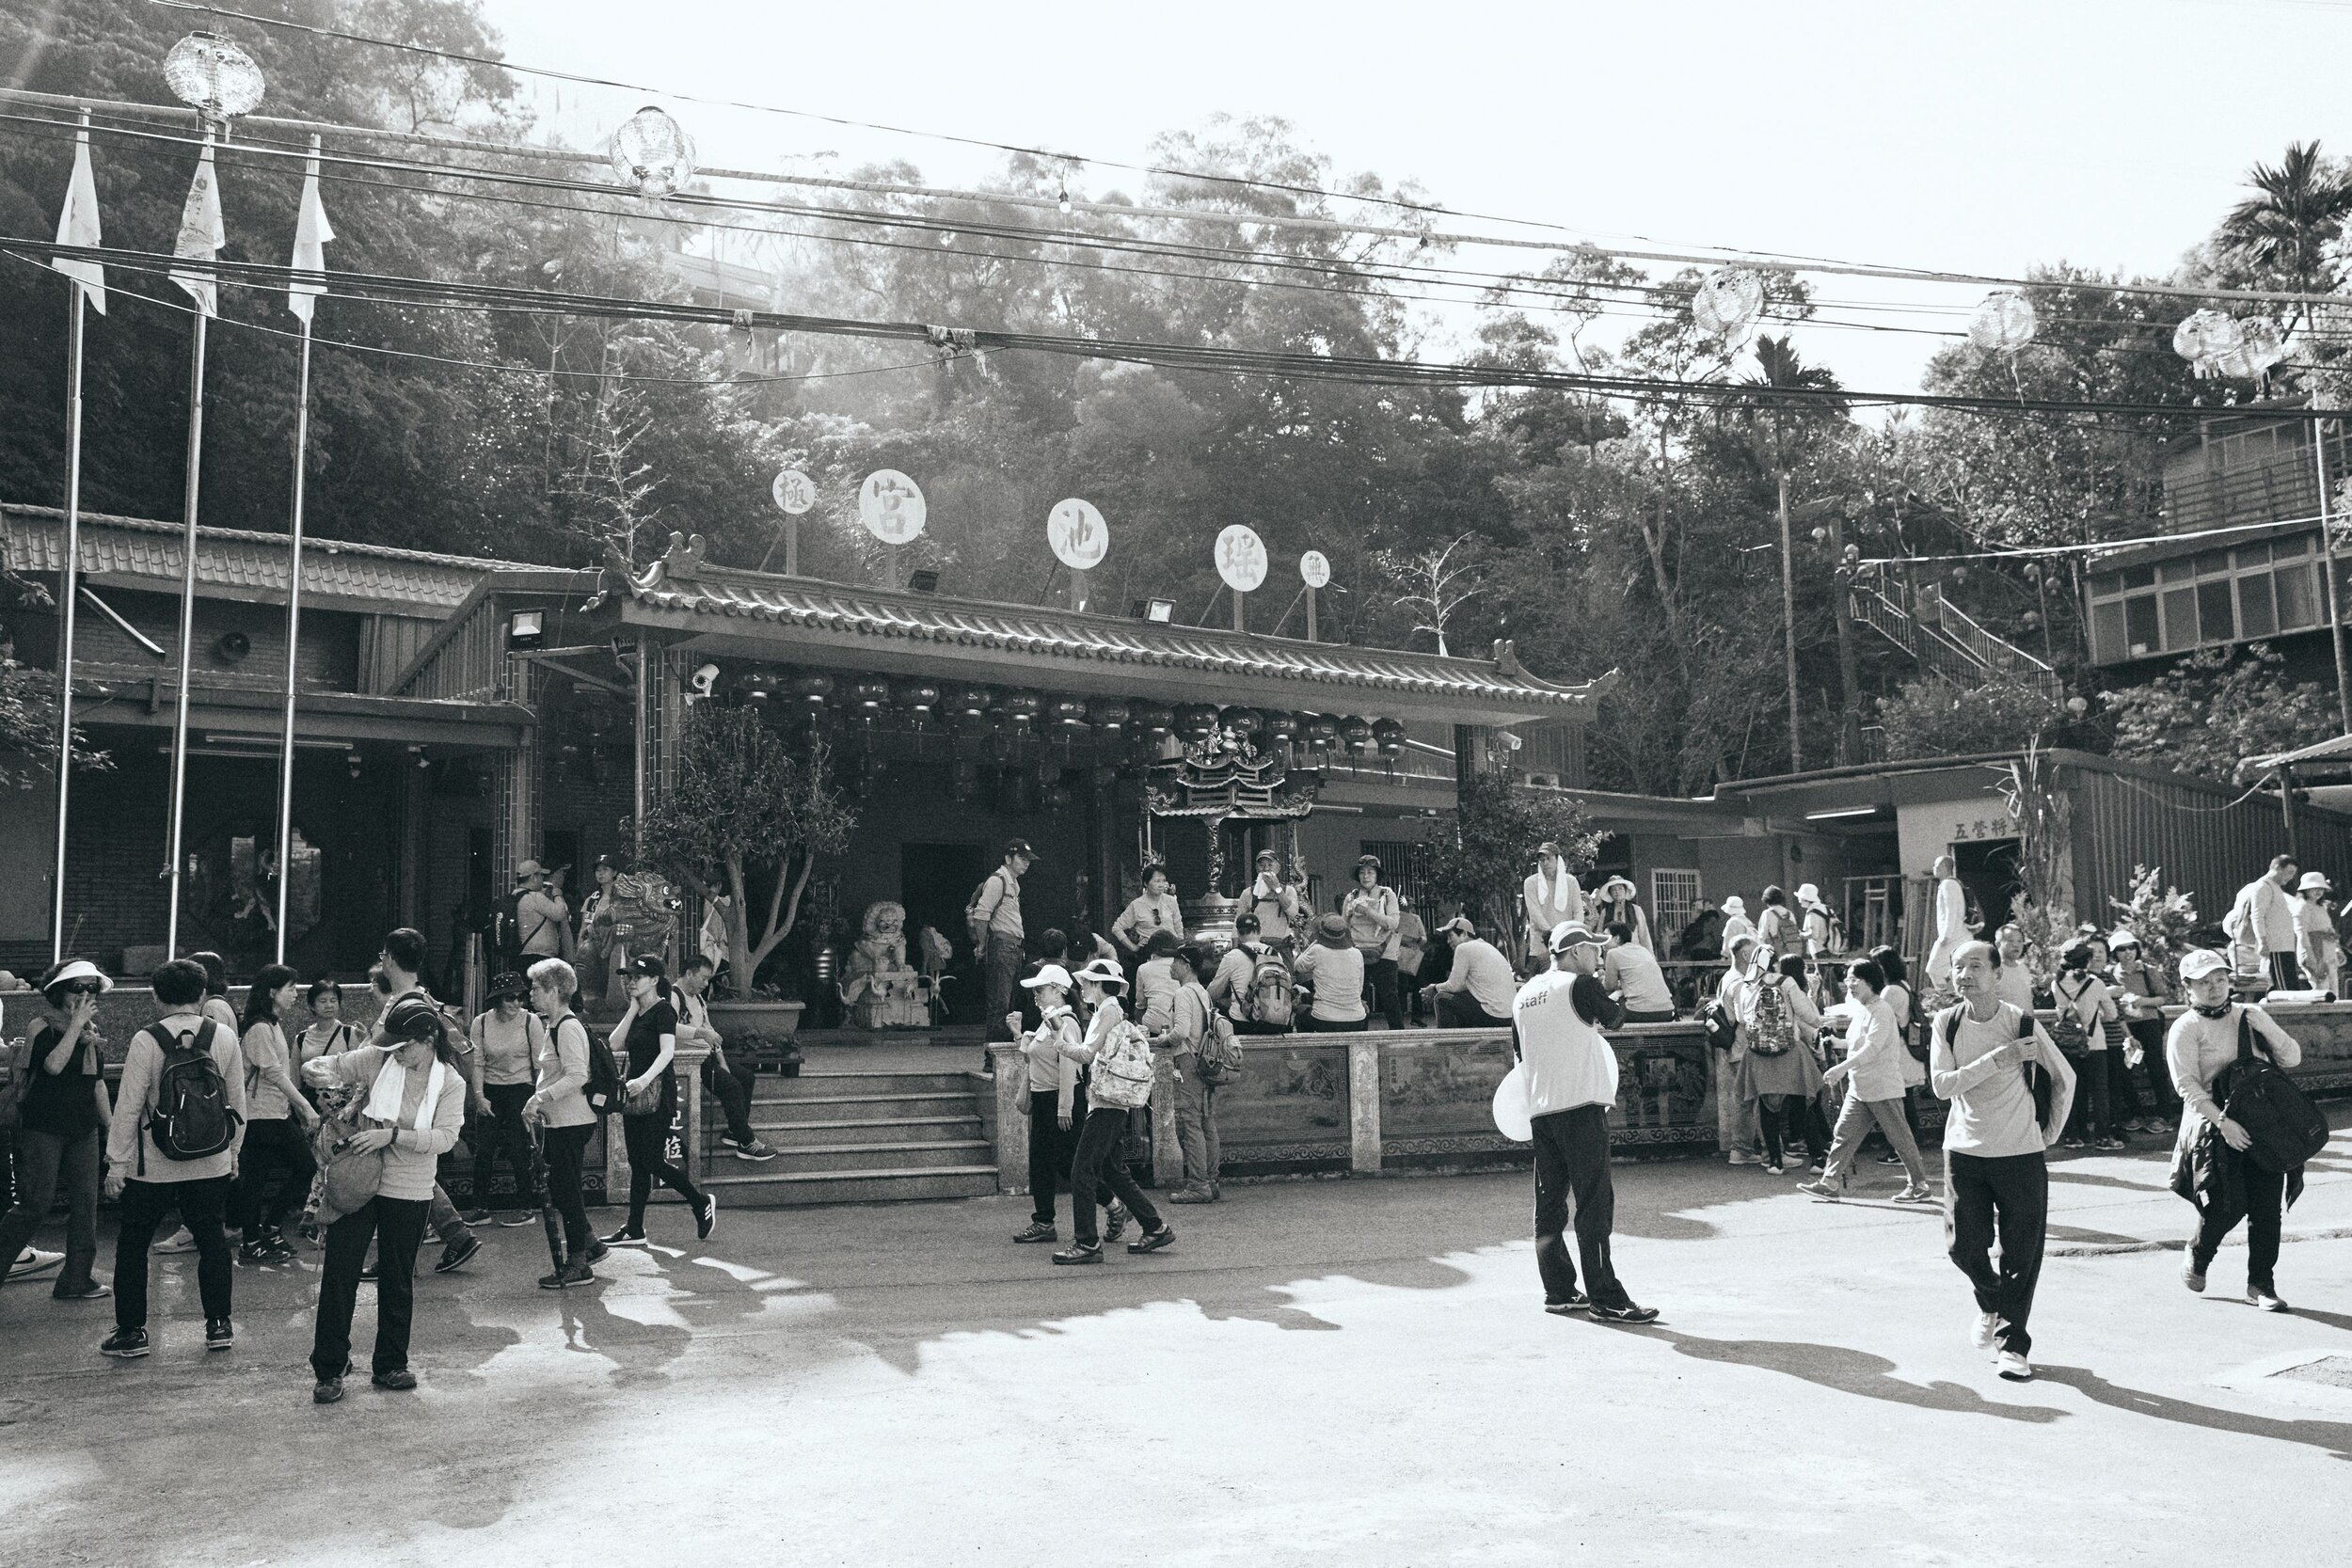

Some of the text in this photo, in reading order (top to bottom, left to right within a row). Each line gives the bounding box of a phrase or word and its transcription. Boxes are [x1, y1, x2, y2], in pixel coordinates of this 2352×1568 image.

[779, 473, 808, 508] 極
[873, 477, 916, 535] 宮
[1058, 508, 1101, 559] 池
